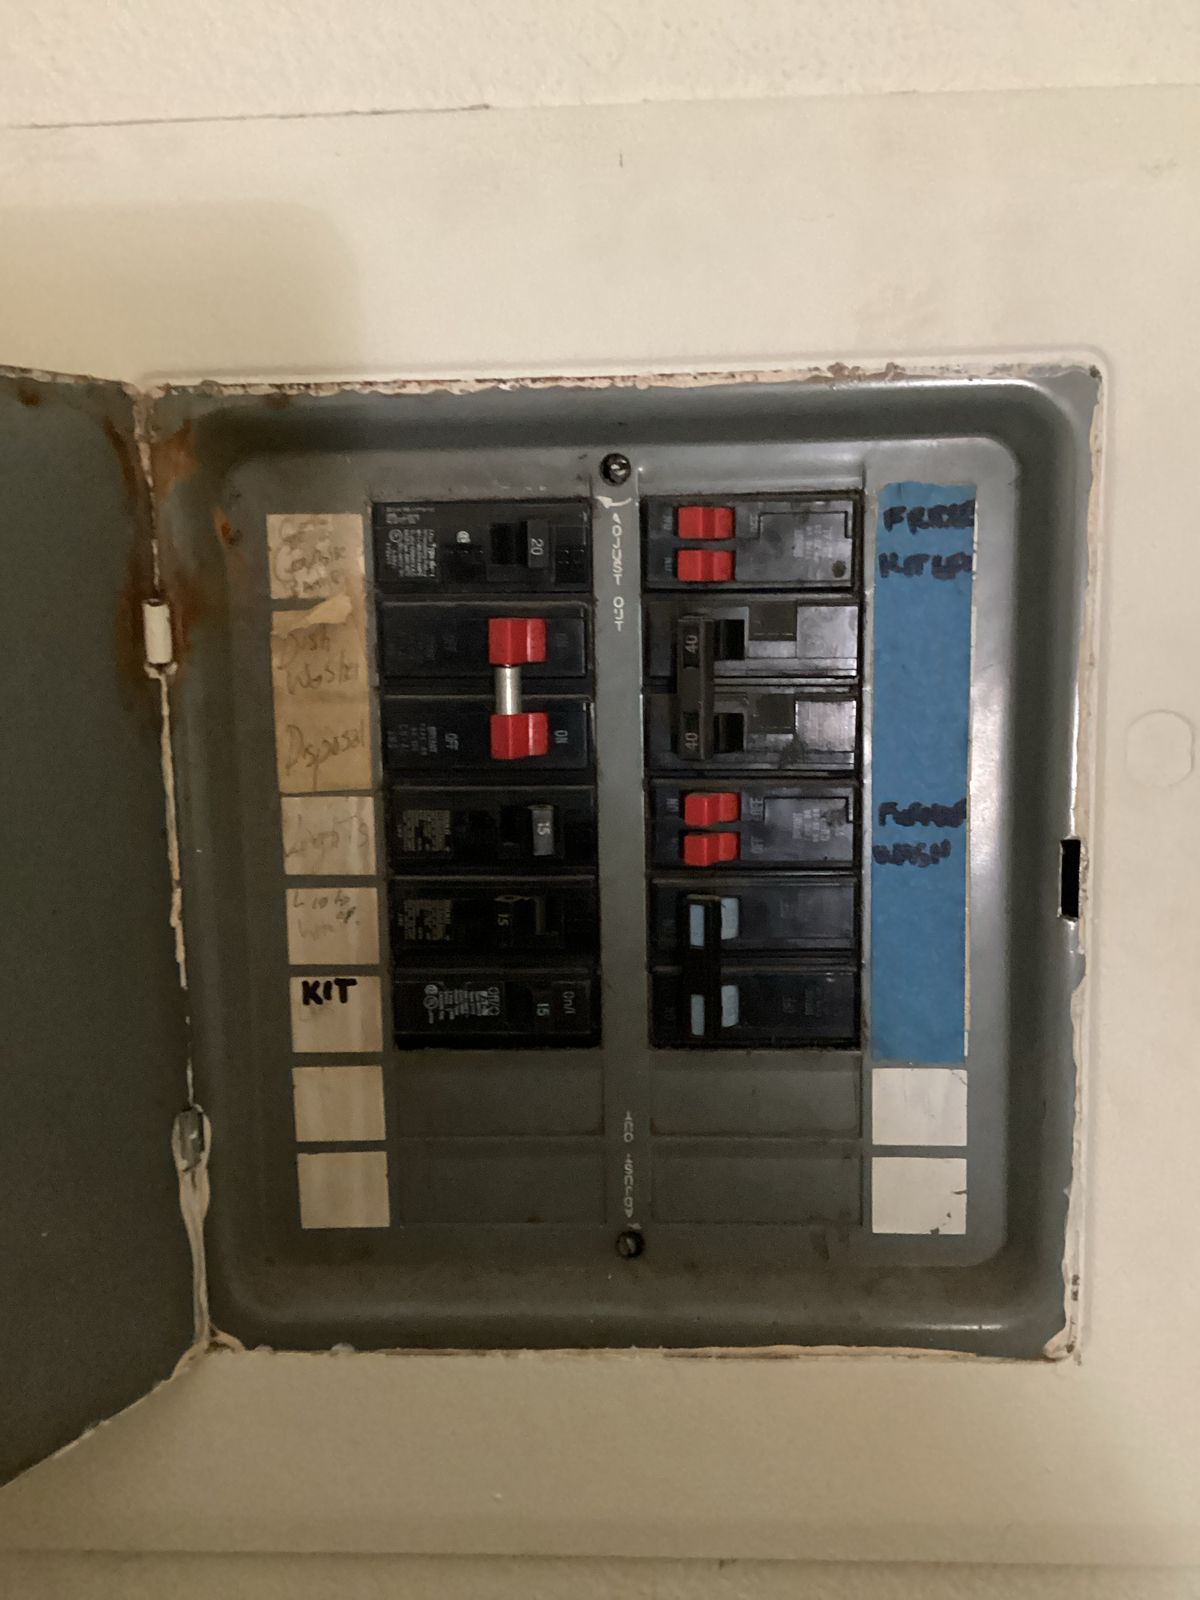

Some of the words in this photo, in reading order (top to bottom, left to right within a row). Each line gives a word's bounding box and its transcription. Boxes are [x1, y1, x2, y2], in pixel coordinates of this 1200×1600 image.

[530, 538, 544, 556] 20
[684, 634, 699, 654] 40
[555, 729, 569, 744] ON
[684, 731, 699, 750] 40
[536, 822, 551, 836] 15
[497, 913, 509, 927] 15
[301, 977, 358, 1006] KIT
[536, 1003, 550, 1016] 15
